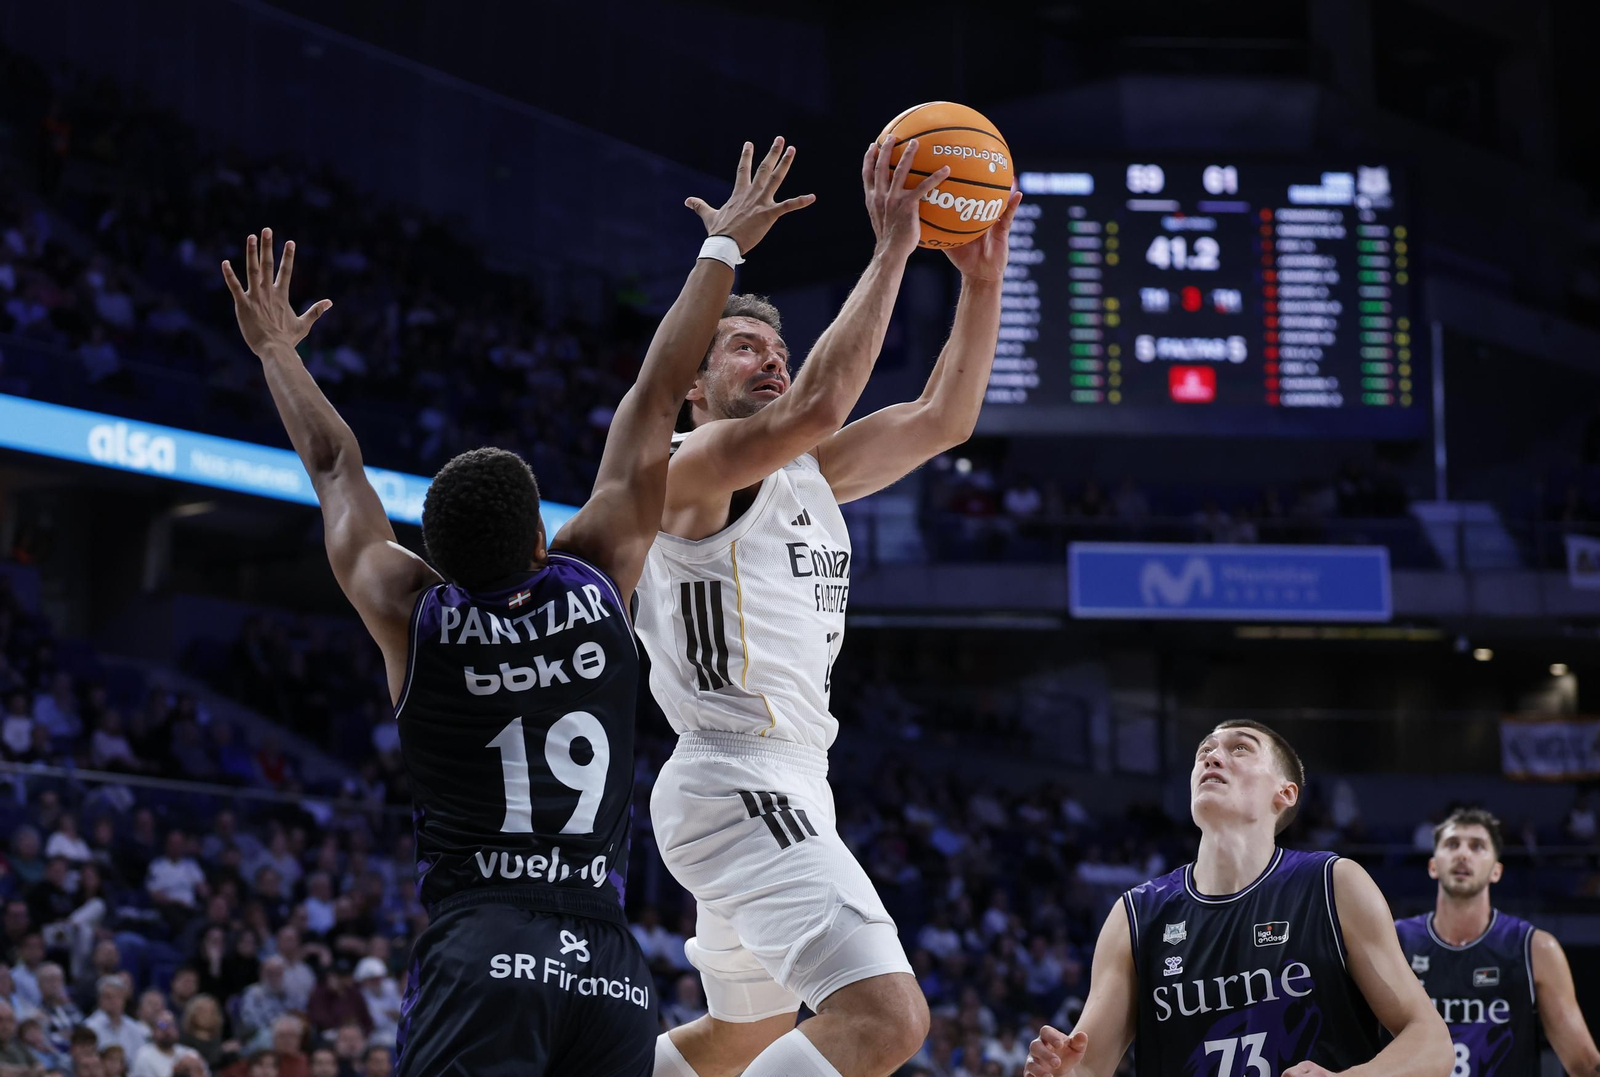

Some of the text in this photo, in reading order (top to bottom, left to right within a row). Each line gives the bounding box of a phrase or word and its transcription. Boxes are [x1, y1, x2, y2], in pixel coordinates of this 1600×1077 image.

[933, 145, 990, 160] endesa
[922, 188, 1003, 222] Wilson
[1146, 235, 1220, 271] 41.2
[88, 422, 176, 474] alsa
[785, 542, 850, 579] Emira
[440, 584, 610, 644] PANTZAR
[464, 655, 571, 696] bbk
[485, 711, 610, 834] 19
[489, 954, 537, 980] SR
[1153, 961, 1313, 1022] surne
[1431, 998, 1510, 1024] rne
[1204, 1031, 1271, 1077] 73
